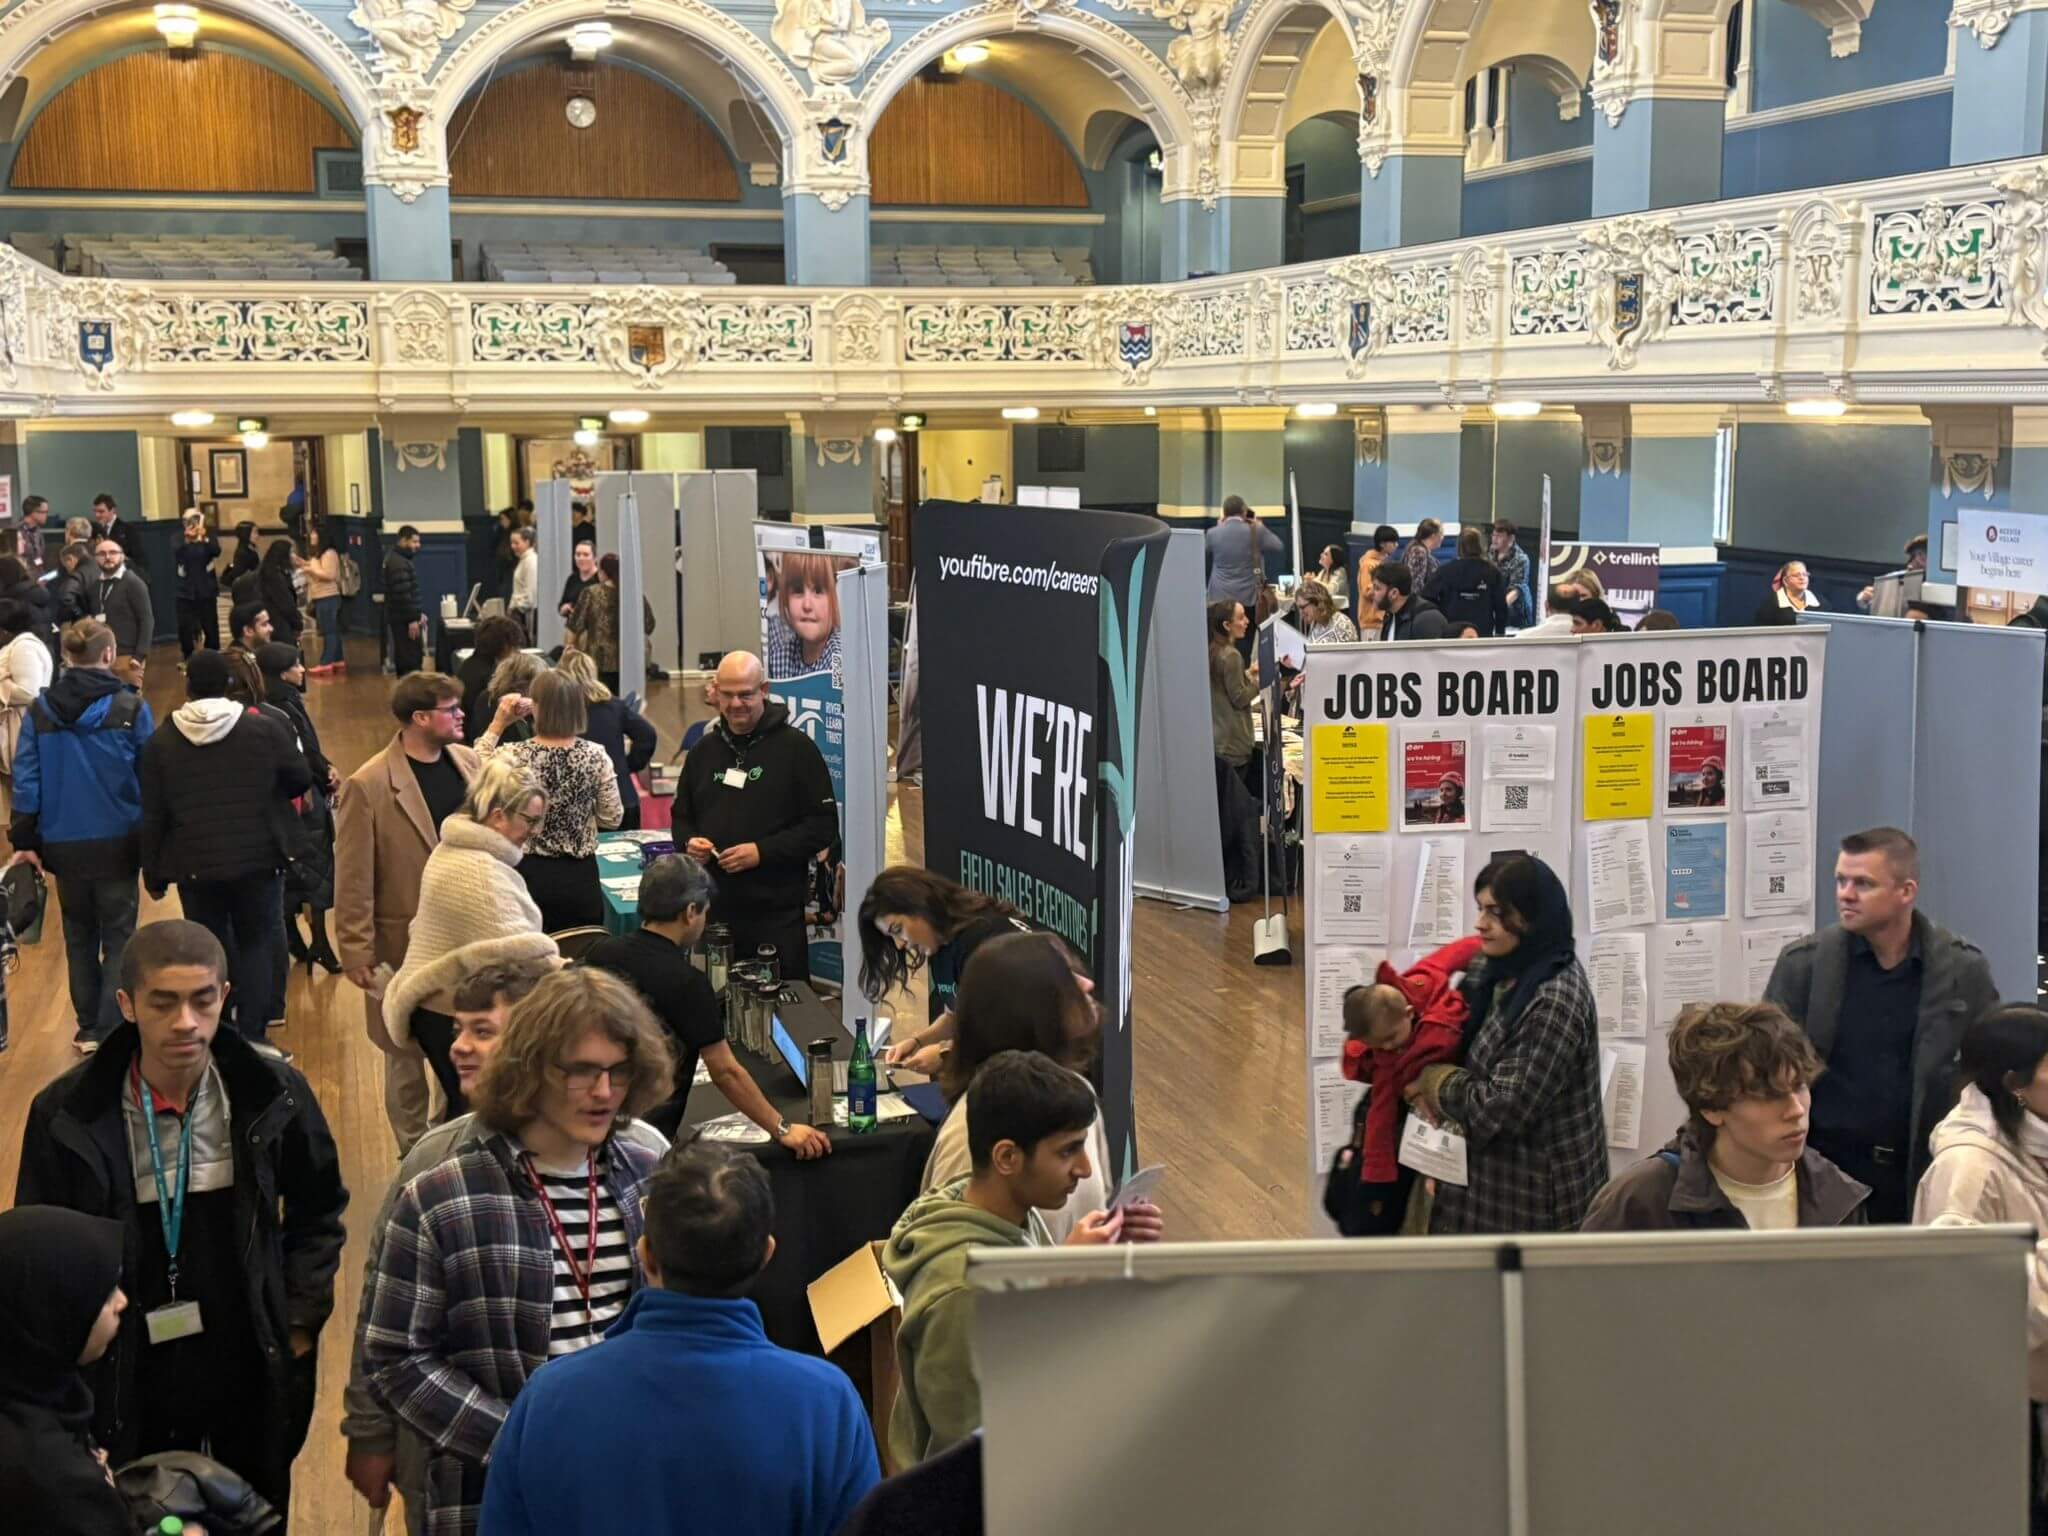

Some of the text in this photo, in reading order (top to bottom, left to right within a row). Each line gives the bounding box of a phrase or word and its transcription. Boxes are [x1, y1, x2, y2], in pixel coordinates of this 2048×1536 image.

[939, 554, 1099, 597] youfibre.com/careers
[1608, 551, 1659, 566] trellint
[1324, 668, 1560, 720] JOBS BOARD
[1591, 655, 1809, 709] JOBS BOARD
[825, 716, 842, 730] LEARN
[976, 683, 1094, 862] WE'RE
[960, 849, 1089, 954] FIELD SALES EXECUTIVES
